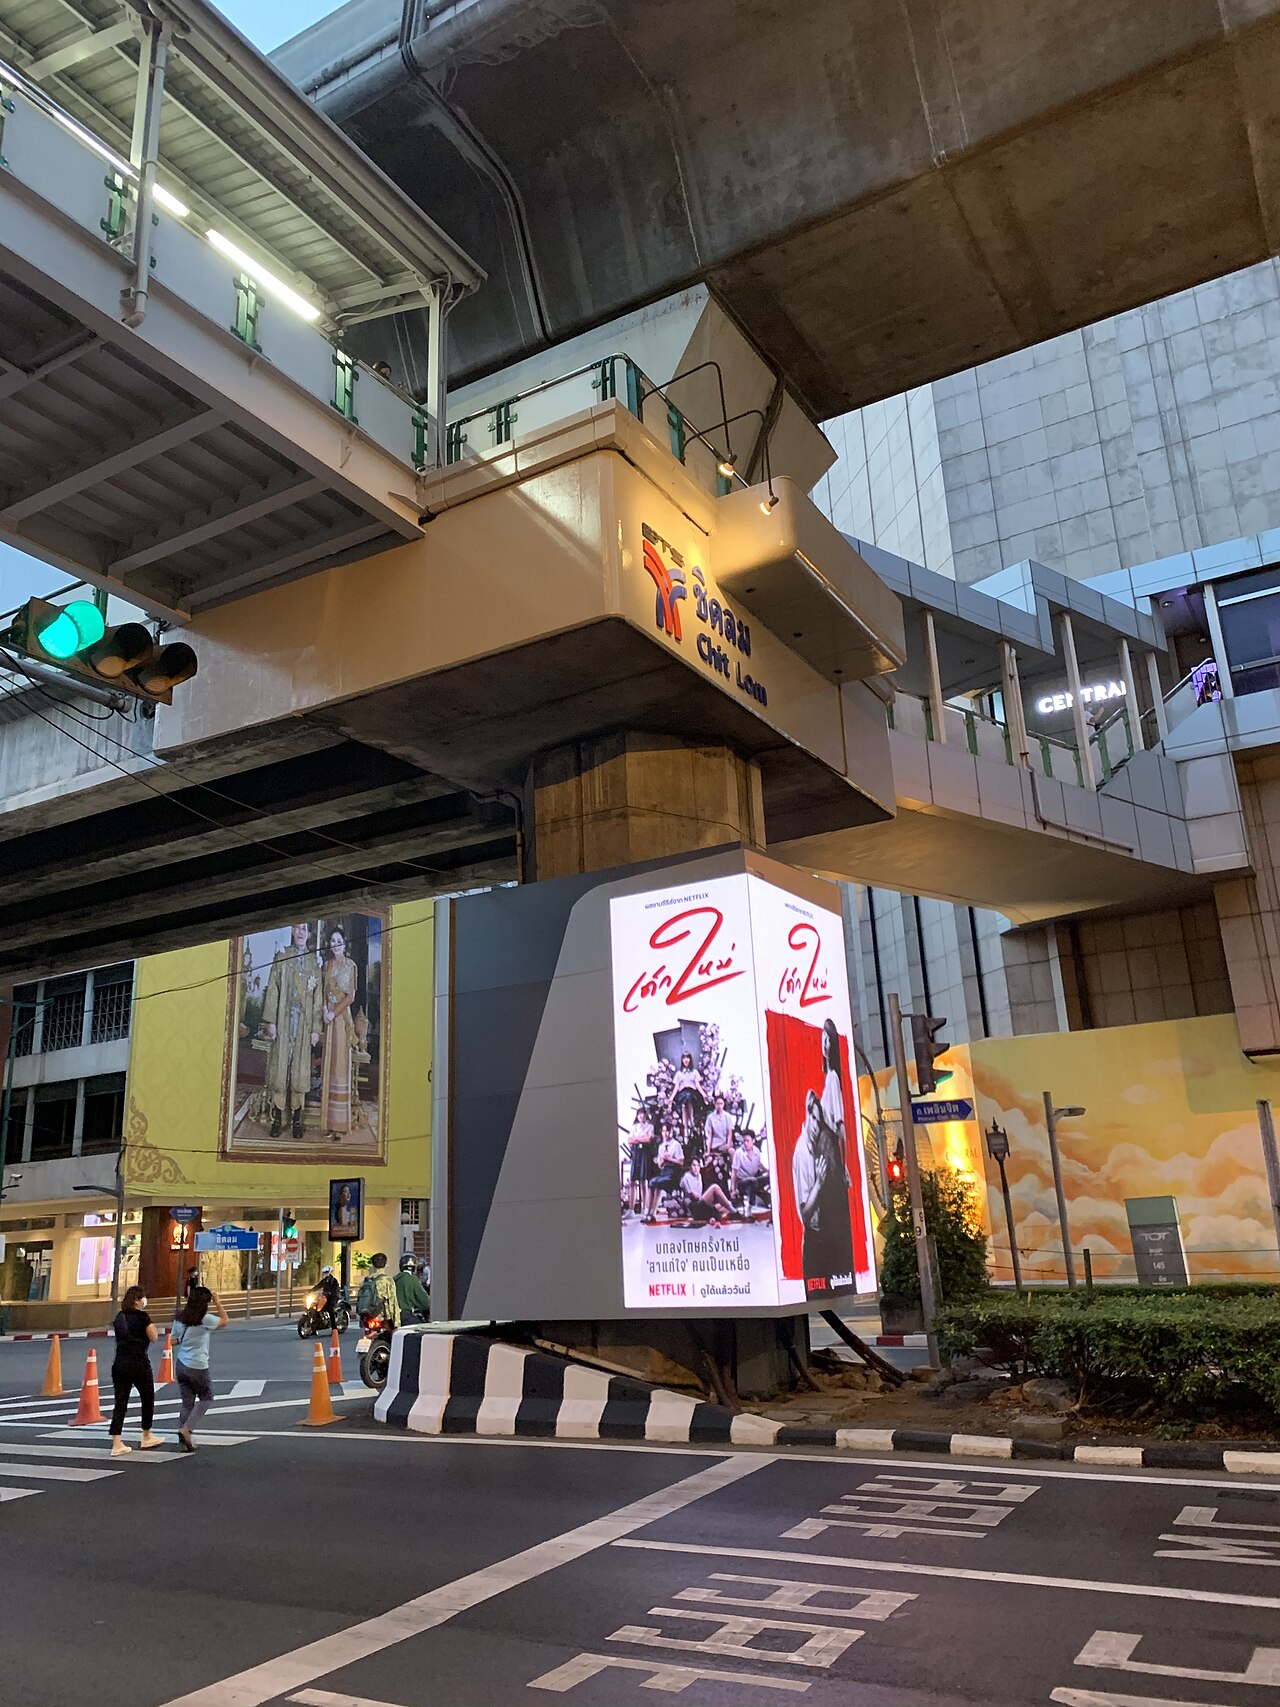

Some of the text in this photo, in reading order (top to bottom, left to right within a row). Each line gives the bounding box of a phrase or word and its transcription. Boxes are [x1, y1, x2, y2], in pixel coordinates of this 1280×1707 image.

[692, 566, 752, 657] ชิดลม
[697, 633, 768, 707] Chit Lom
[683, 892, 710, 903] NETFLIX
[692, 1253, 751, 1272] คนเป็นเหยื่อ
[648, 1282, 751, 1298] NETFLIX ดูได้แล้ววันนี้
